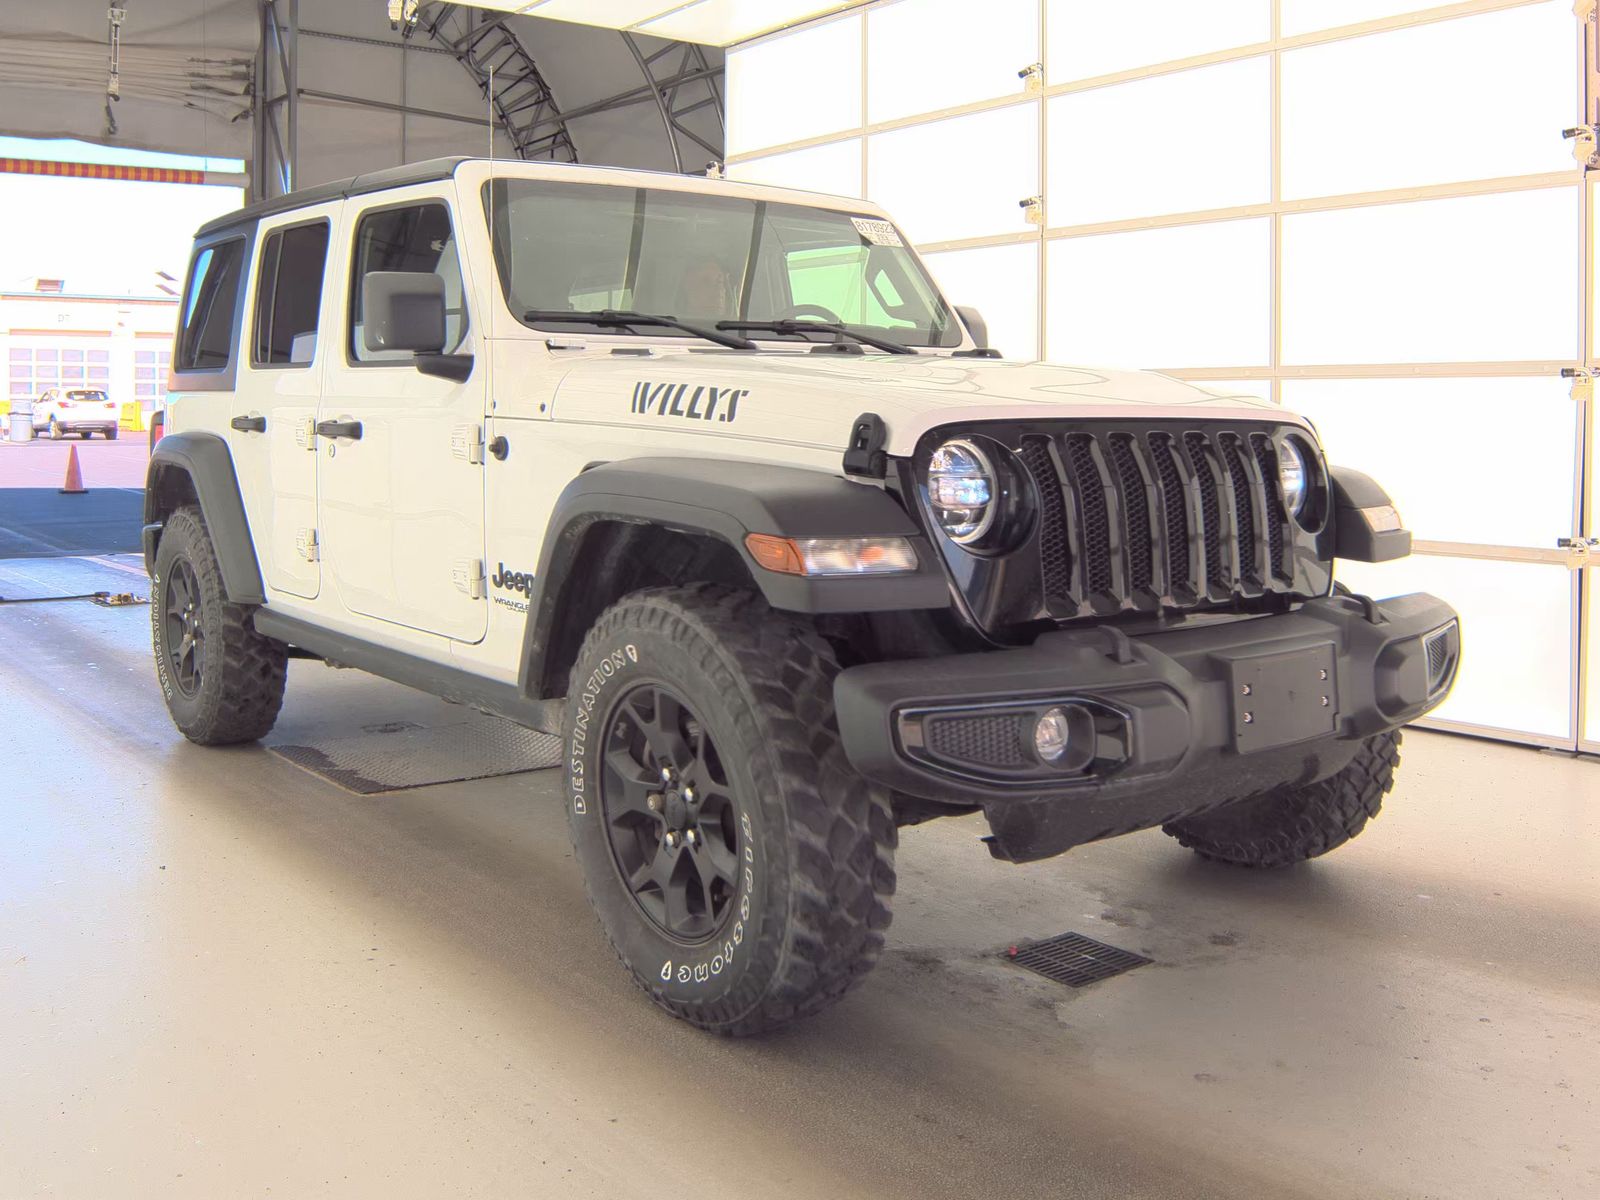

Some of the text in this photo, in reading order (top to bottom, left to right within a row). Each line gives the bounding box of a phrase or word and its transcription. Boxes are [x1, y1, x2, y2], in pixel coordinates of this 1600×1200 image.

[631, 381, 750, 422] WILLYS
[492, 562, 534, 599] Jeep
[493, 596, 529, 610] WRANGLE
[571, 649, 627, 814] DESTINATION
